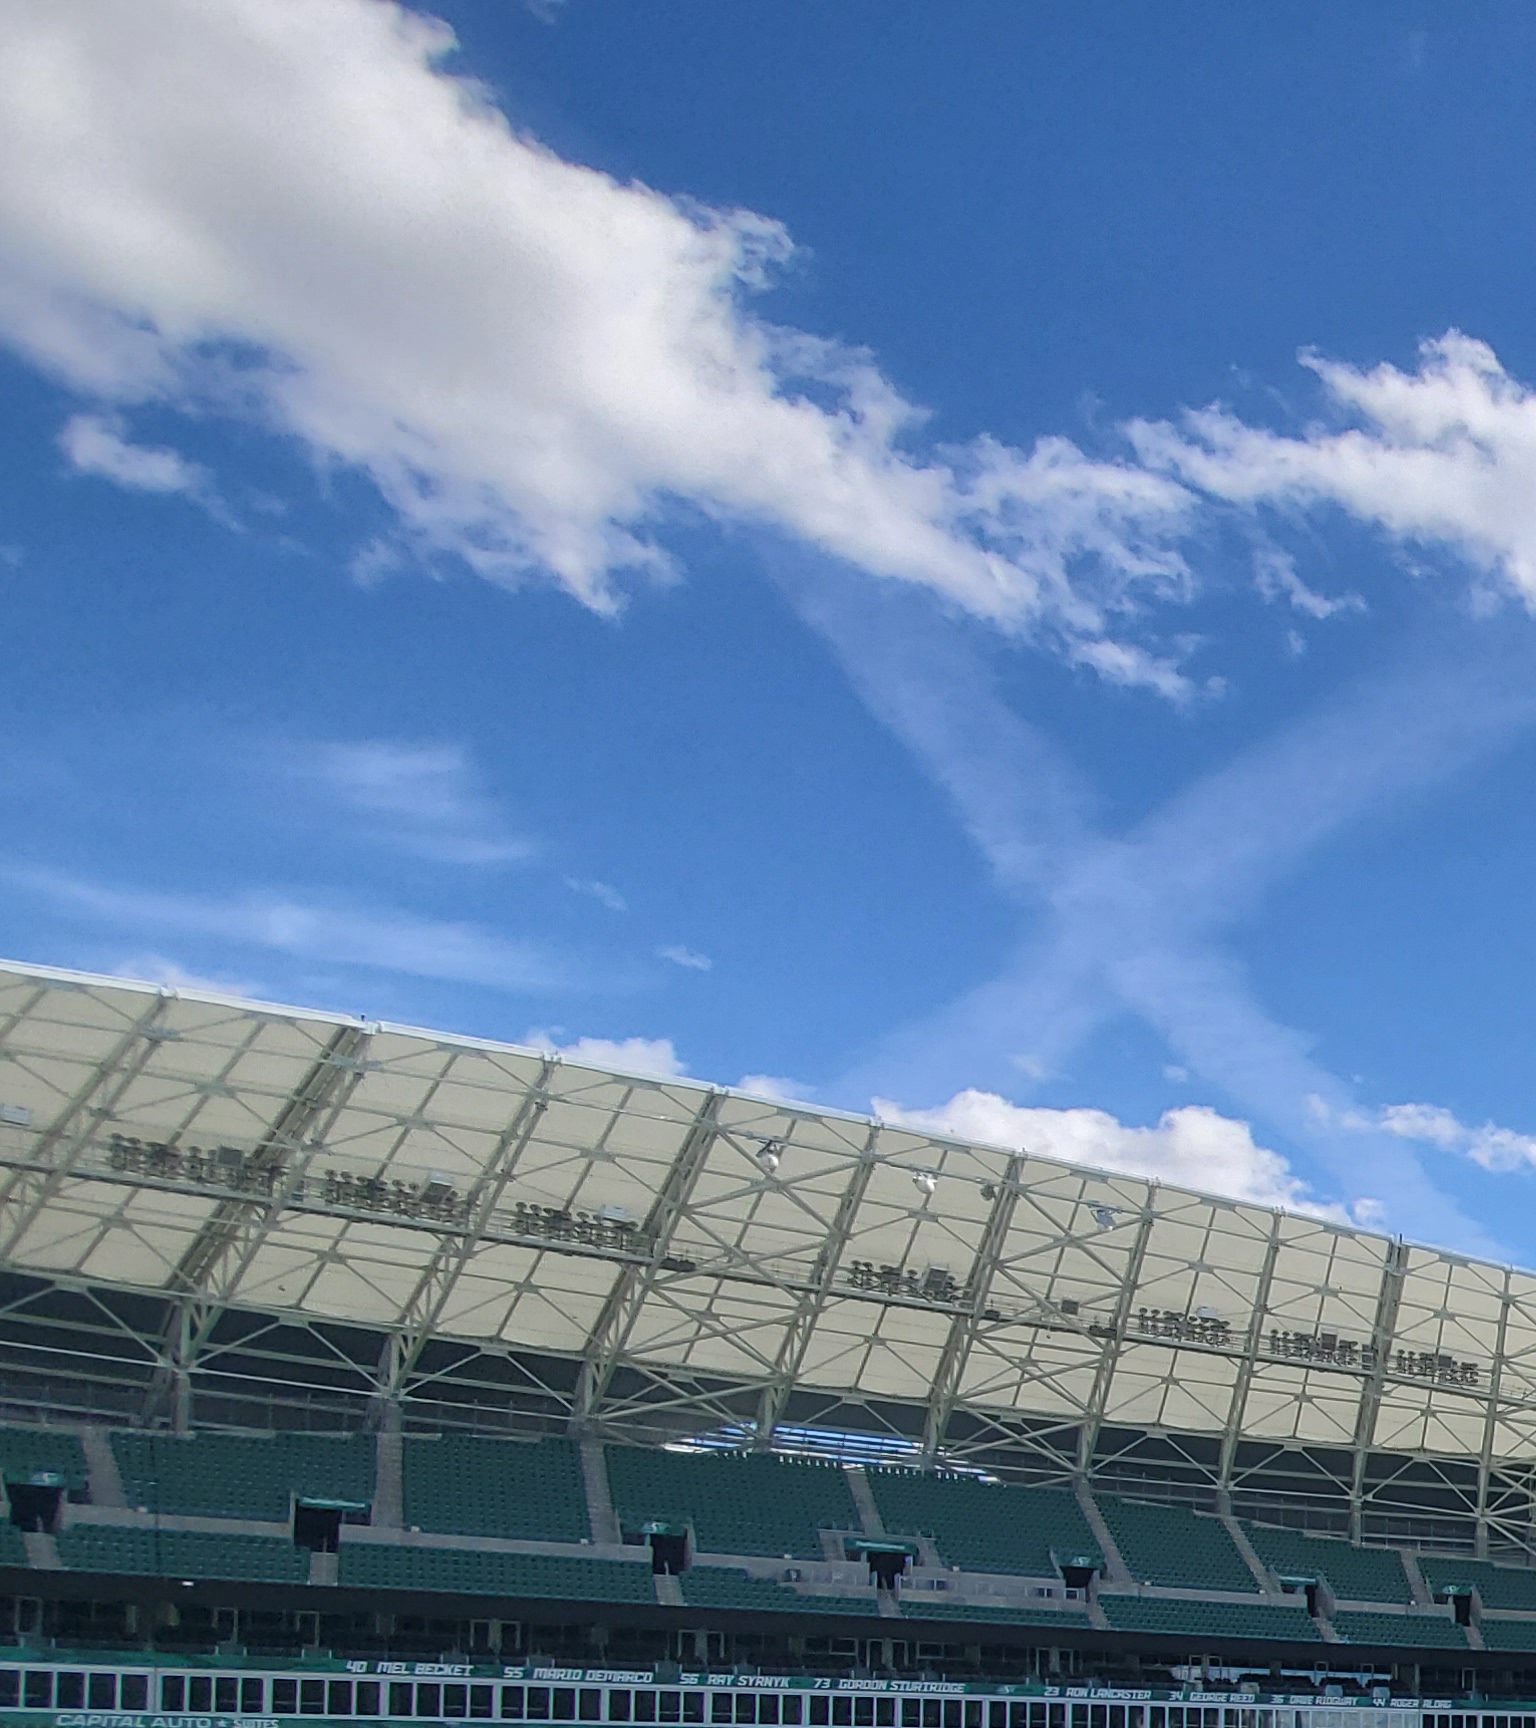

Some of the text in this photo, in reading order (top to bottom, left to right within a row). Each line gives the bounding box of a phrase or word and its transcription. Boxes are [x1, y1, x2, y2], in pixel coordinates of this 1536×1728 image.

[346, 1661, 474, 1677] 40 MEL BECKET
[504, 1667, 654, 1683] 55 MARIO DEMARCO
[679, 1674, 699, 1685] 56
[707, 1675, 734, 1686] RAY
[814, 1678, 966, 1693] 73 GORDON STURTRIDGE
[1044, 1687, 1152, 1700] 23 RON LANCASTER
[1168, 1691, 1255, 1703] 34 GEORGE REED
[1390, 1698, 1419, 1708] ROGER
[56, 1714, 146, 1728] CAPITAL
[151, 1716, 211, 1728] AUTO
